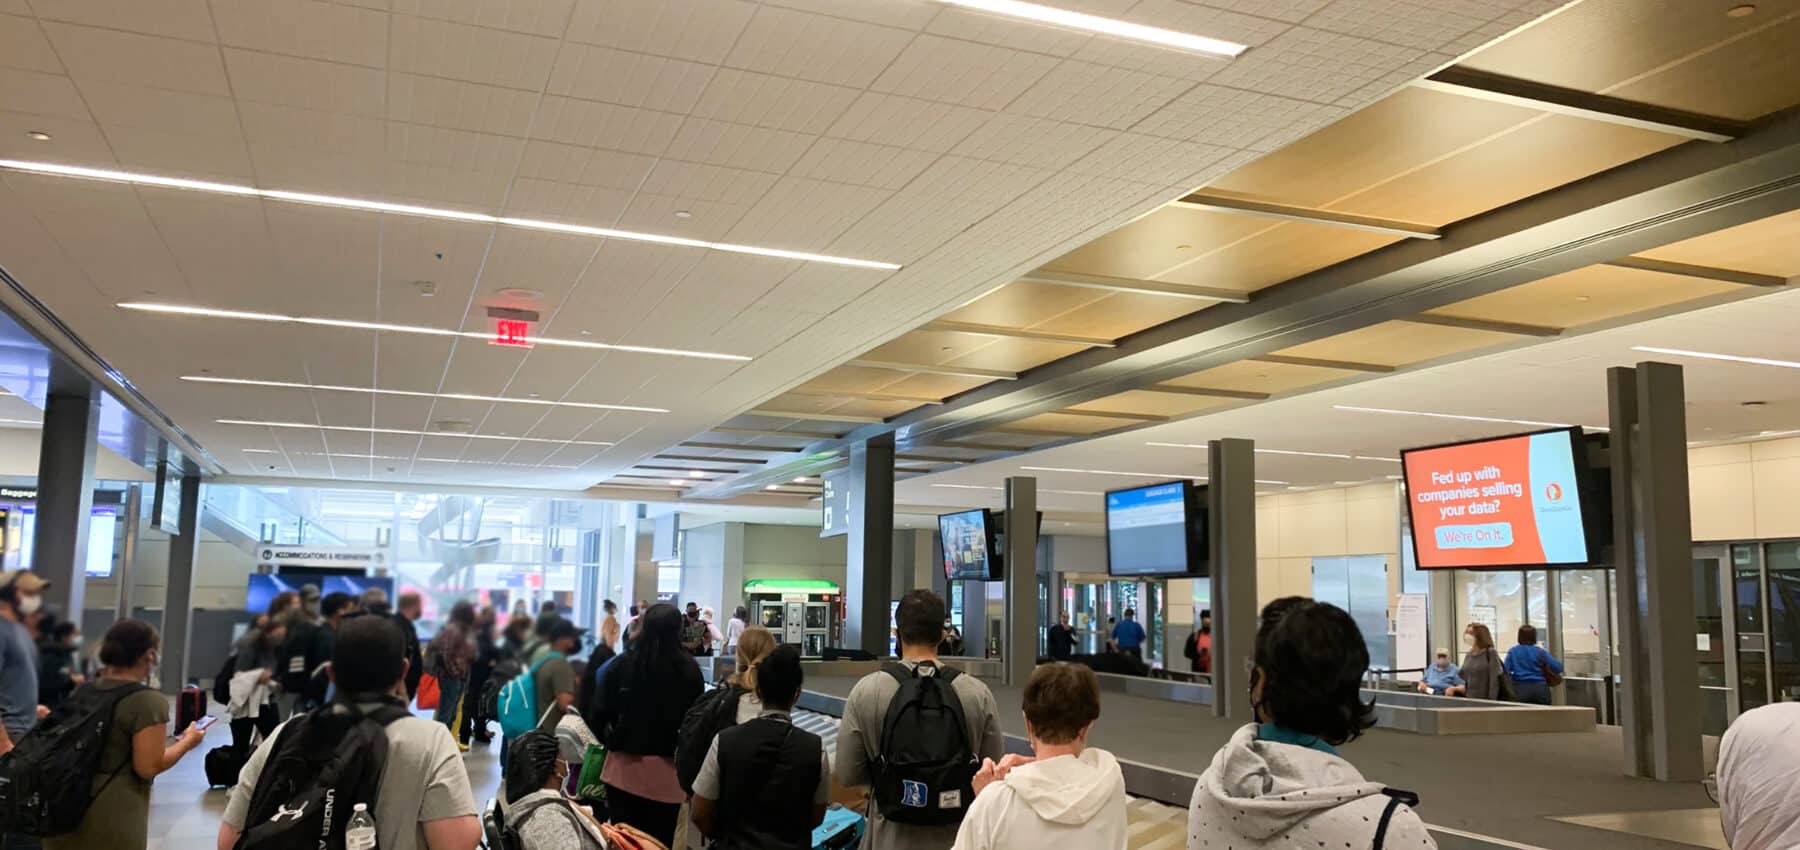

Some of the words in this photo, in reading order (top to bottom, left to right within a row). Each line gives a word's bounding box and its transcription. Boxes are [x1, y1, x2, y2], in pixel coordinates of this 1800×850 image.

[498, 320, 528, 344] EXIT
[1431, 470, 1454, 485] Fed
[1456, 471, 1472, 484] up
[1474, 466, 1500, 480] with
[1, 489, 37, 498] Baggage
[1417, 487, 1480, 503] companies
[1481, 481, 1522, 497] selling
[1440, 505, 1466, 520] your
[1468, 499, 1501, 515] data?
[1444, 531, 1473, 543] We're
[1475, 529, 1492, 541] On
[321, 789, 335, 837] UNDER
